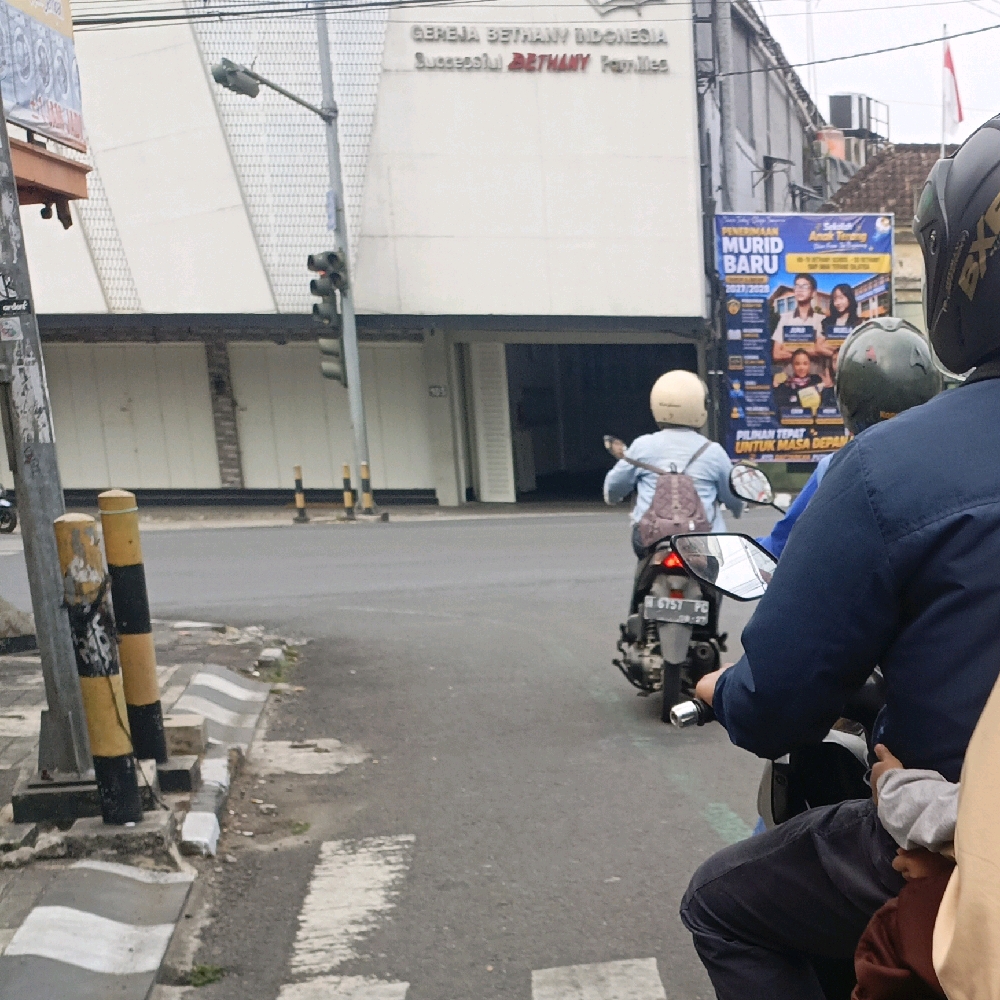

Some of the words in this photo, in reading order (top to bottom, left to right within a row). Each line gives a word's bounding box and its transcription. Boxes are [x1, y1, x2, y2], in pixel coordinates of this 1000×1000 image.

[411, 25, 480, 43] GEREJA
[487, 26, 569, 44] BETHANY
[575, 27, 668, 44] INDONESIA
[508, 52, 591, 72] BETHANY
[722, 236, 784, 254] MURID
[723, 254, 779, 274] BARU
[735, 440, 775, 454] UNTUK
[777, 438, 810, 451] MASA
